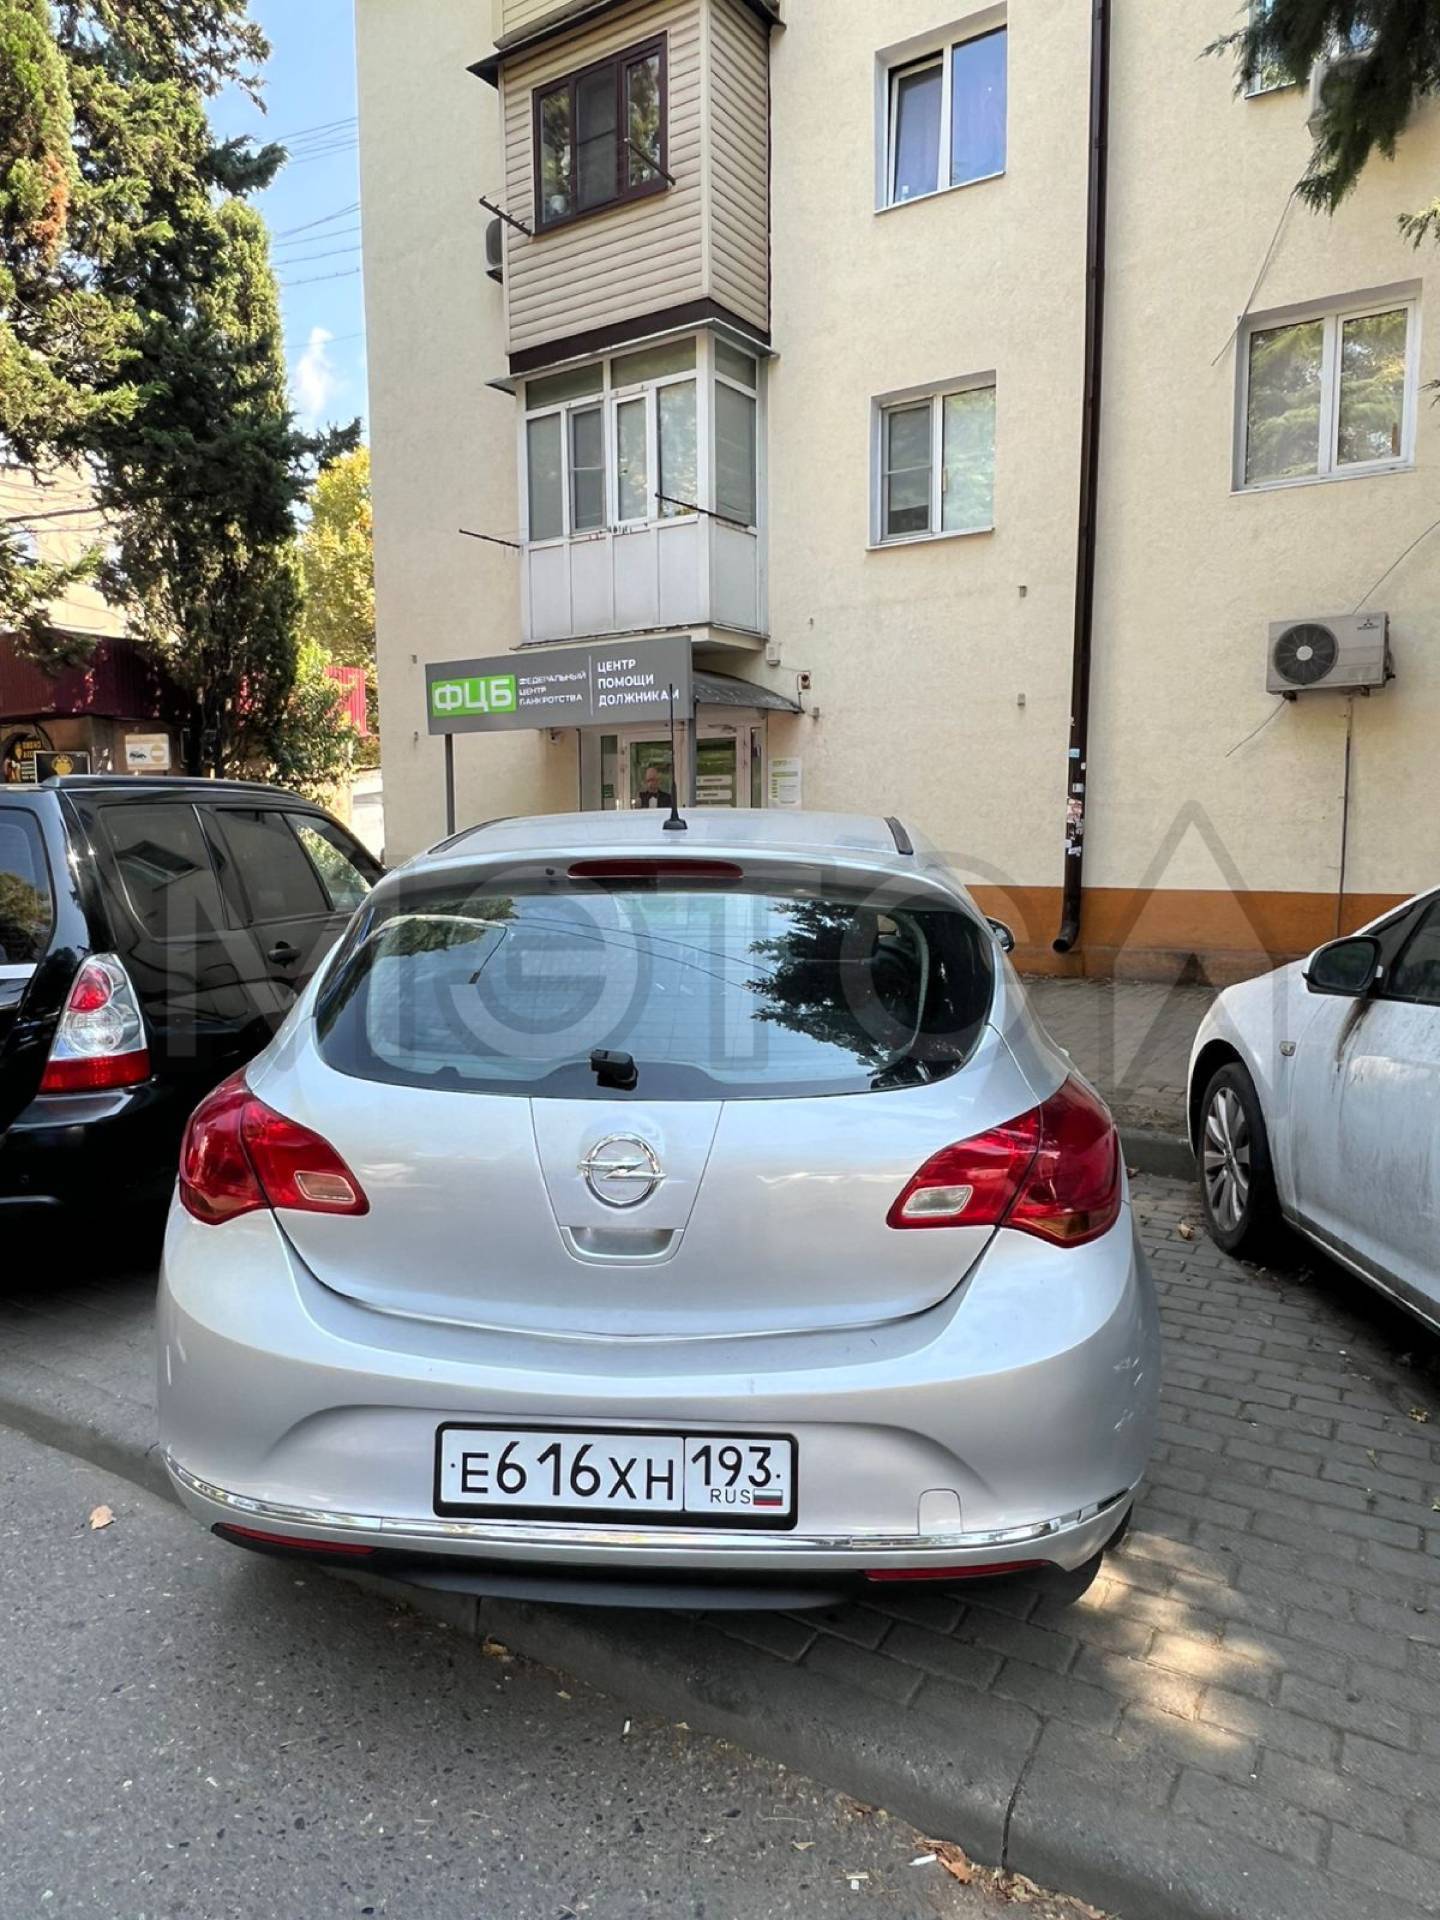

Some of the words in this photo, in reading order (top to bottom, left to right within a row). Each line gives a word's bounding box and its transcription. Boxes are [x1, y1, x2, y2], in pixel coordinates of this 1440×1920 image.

[597, 659, 636, 673] ЦЕНТР
[598, 673, 654, 689] ПОМОЩИ
[434, 678, 512, 712] ФЦБ
[519, 686, 547, 696] ЦЕНТР
[691, 1445, 771, 1488] 193
[710, 1488, 751, 1504] RUS
